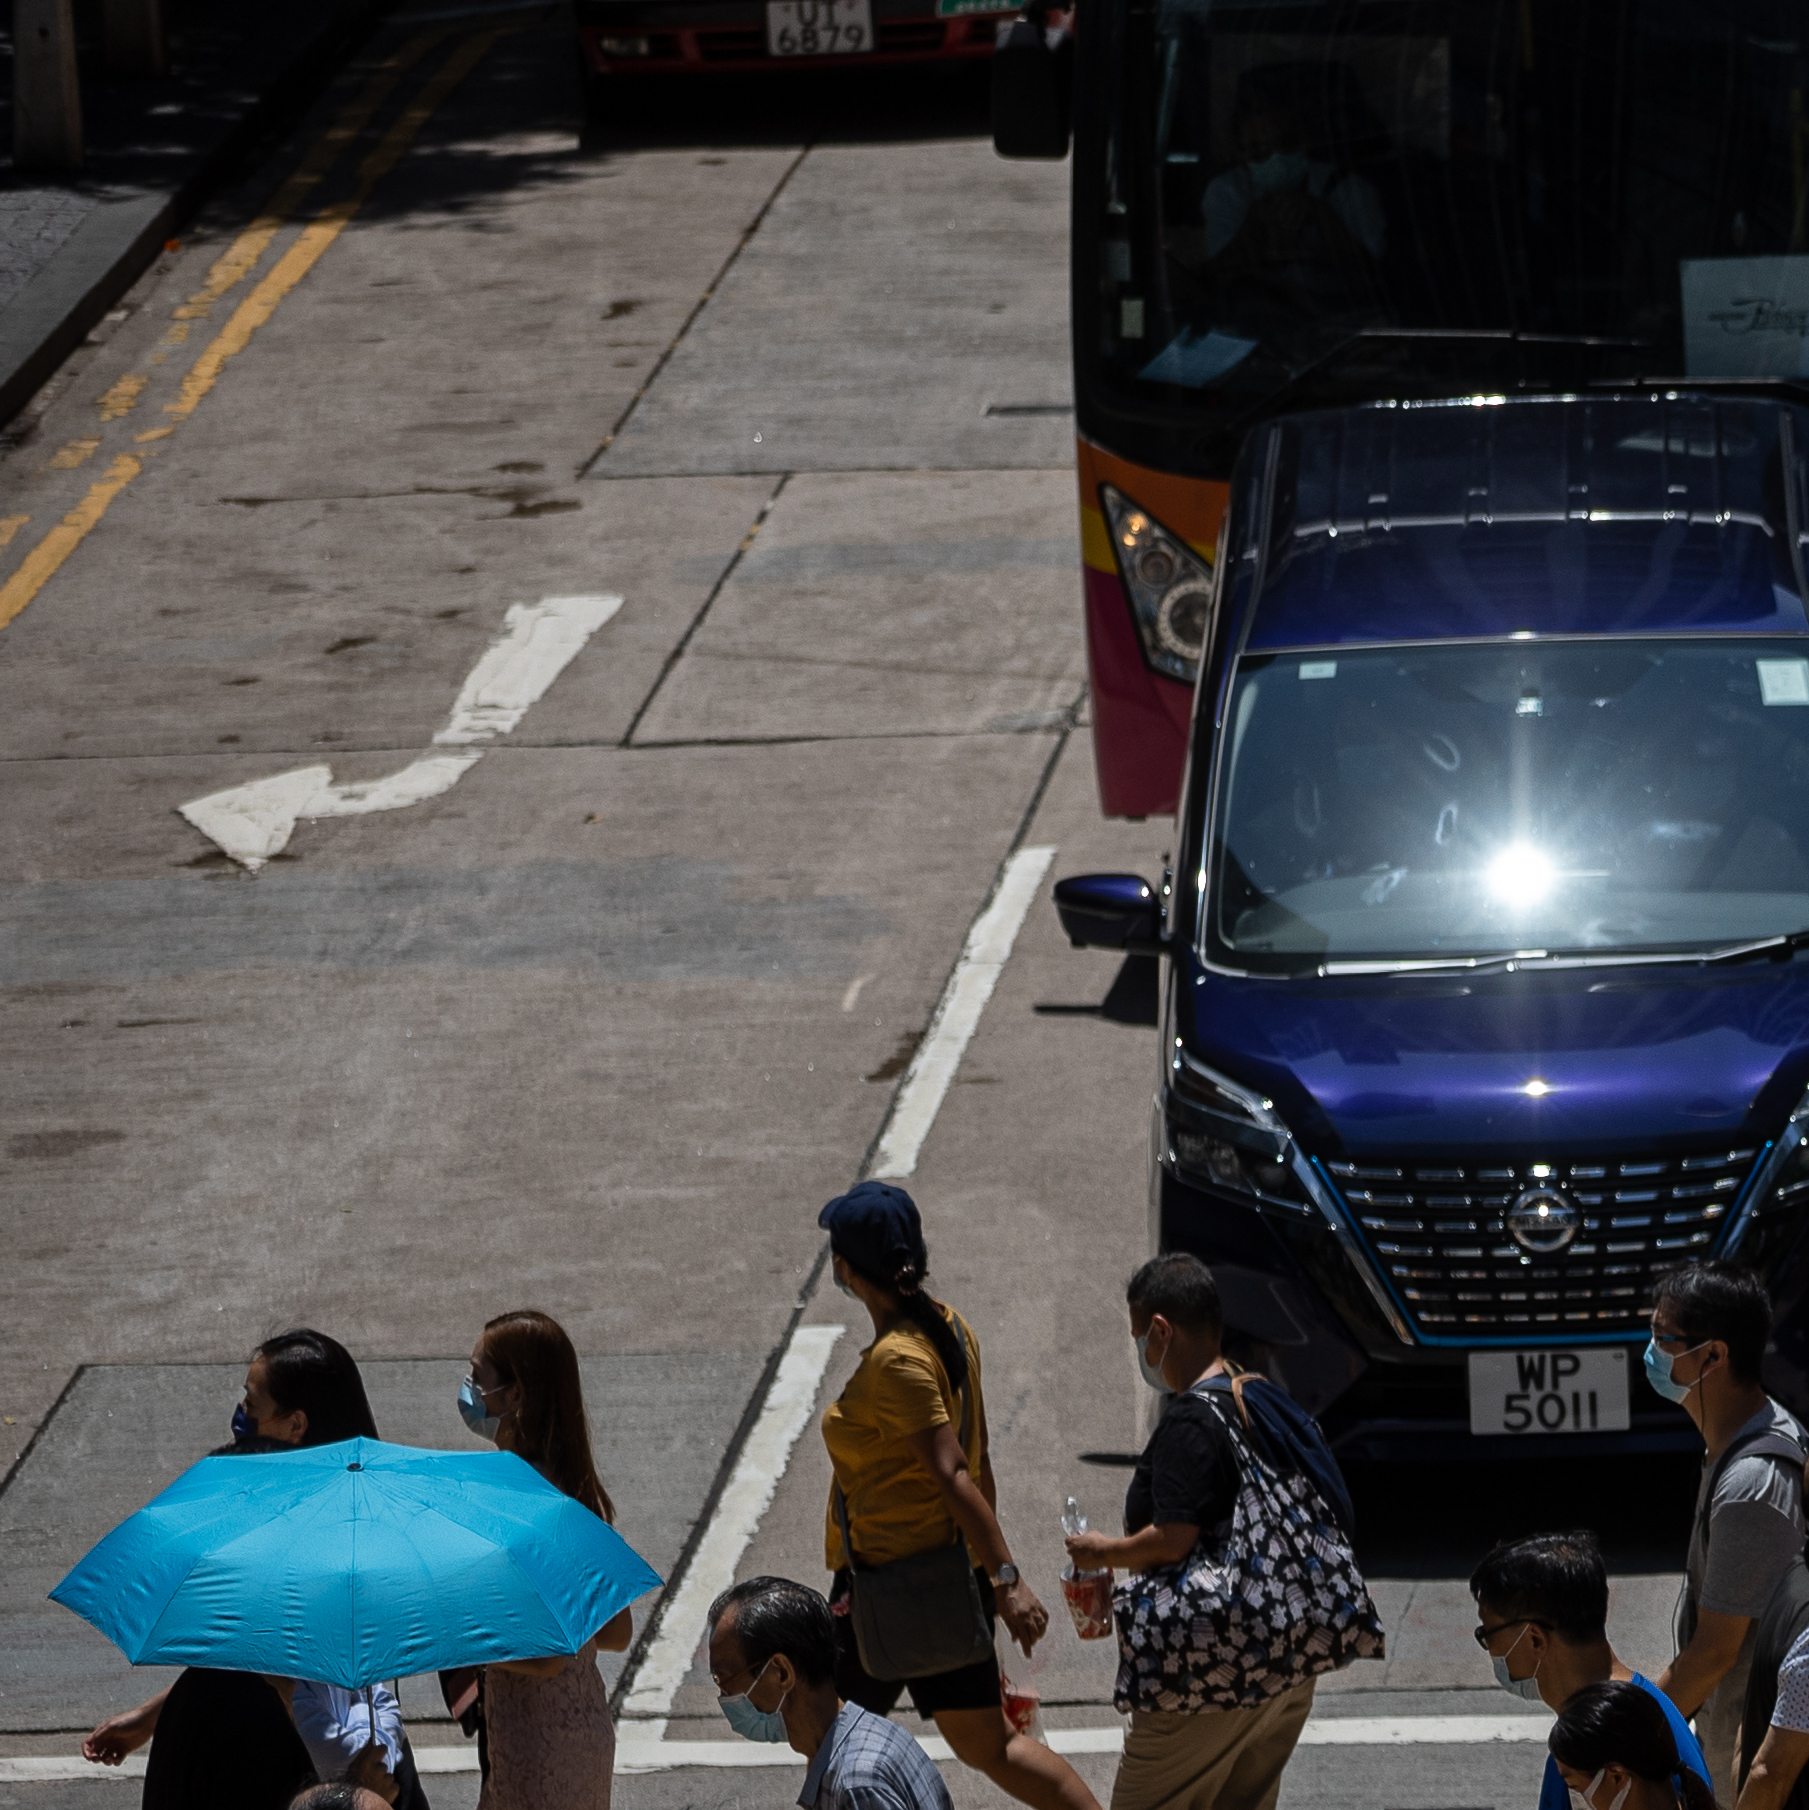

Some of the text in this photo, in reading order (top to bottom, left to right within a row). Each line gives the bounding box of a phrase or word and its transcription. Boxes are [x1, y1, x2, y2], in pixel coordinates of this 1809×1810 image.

[778, 25, 864, 52] 6879
[1516, 1354, 1580, 1391] WP
[1503, 1391, 1598, 1431] 5011
